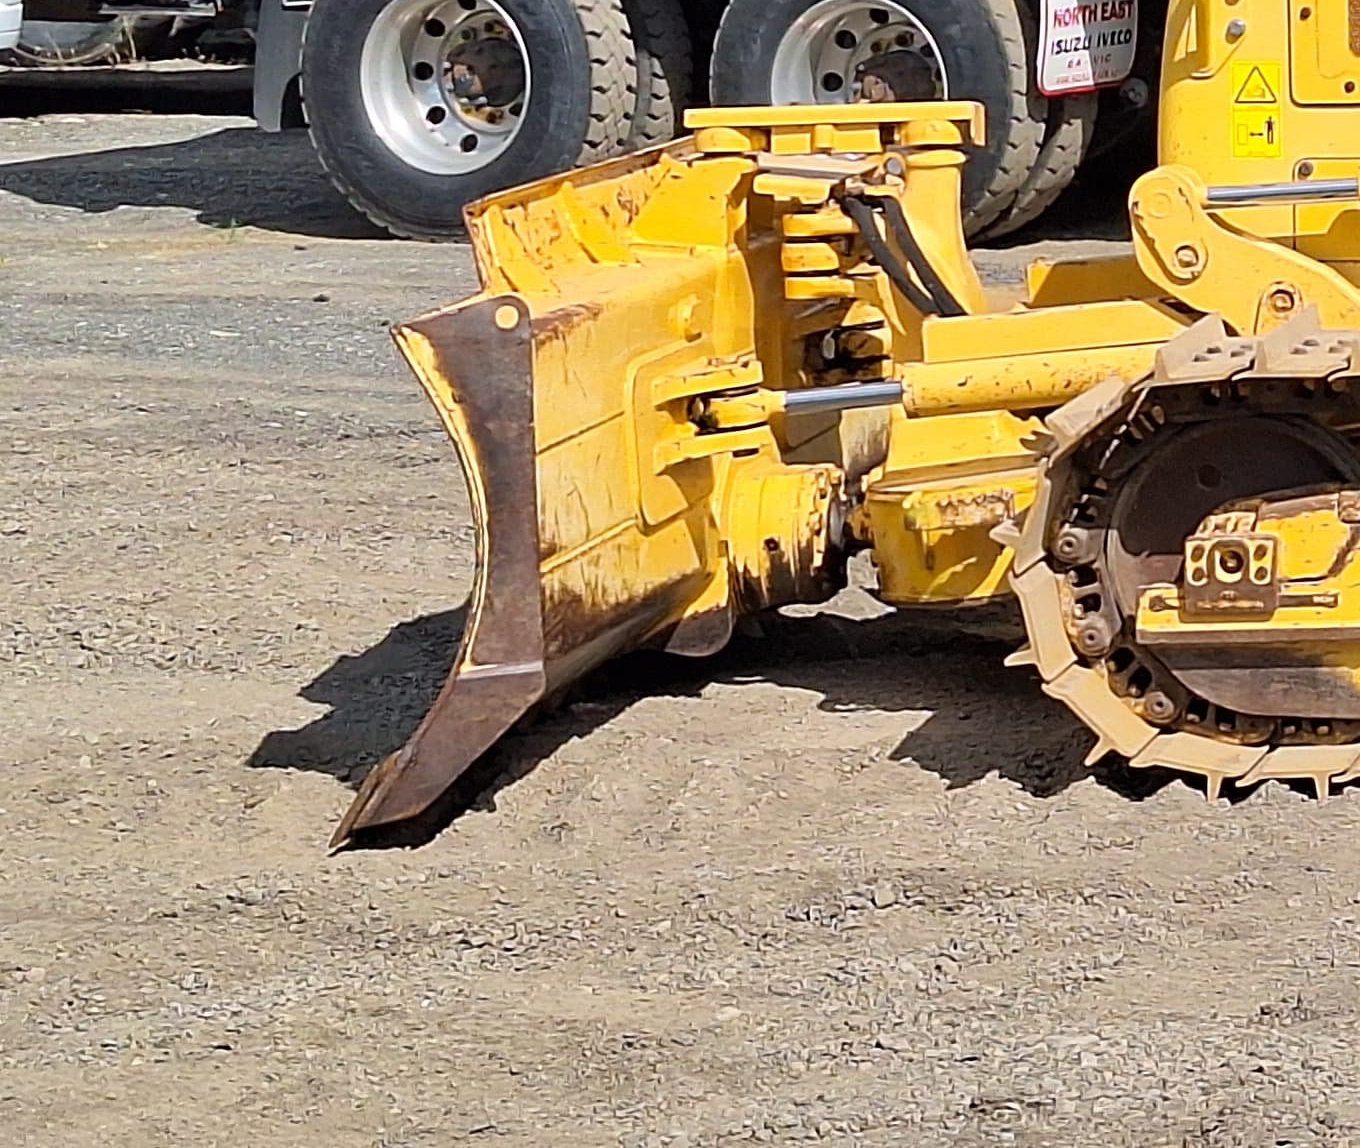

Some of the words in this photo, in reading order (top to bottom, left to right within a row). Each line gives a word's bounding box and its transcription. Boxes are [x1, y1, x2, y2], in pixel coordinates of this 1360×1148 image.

[1053, 4, 1098, 28] NORTH
[1101, 0, 1134, 21] EAST
[1051, 35, 1092, 55] ISUZU
[1097, 28, 1132, 48] IVECO
